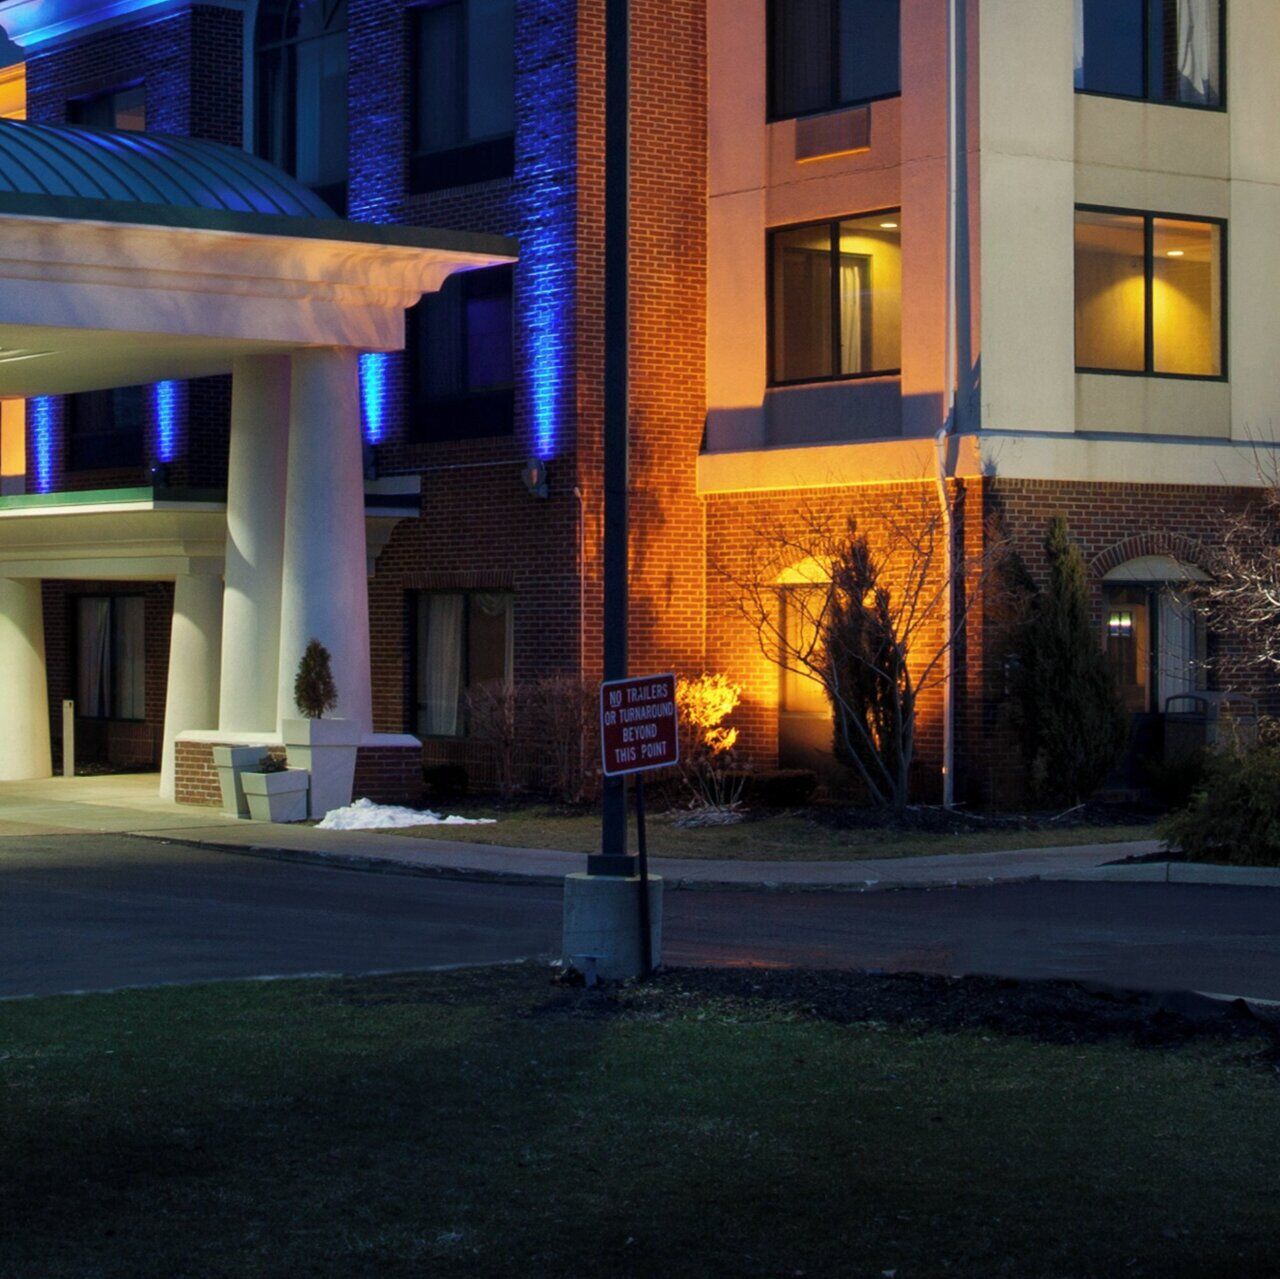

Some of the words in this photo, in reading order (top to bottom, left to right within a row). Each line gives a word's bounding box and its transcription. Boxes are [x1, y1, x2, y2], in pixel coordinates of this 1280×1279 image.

[610, 691, 622, 707] NO
[627, 684, 668, 702] TRAILERS
[604, 711, 616, 726] OR
[620, 702, 673, 723] TURNAROUND
[623, 724, 657, 742] BEYOND
[615, 747, 636, 762] THIS
[642, 741, 667, 758] POINT
